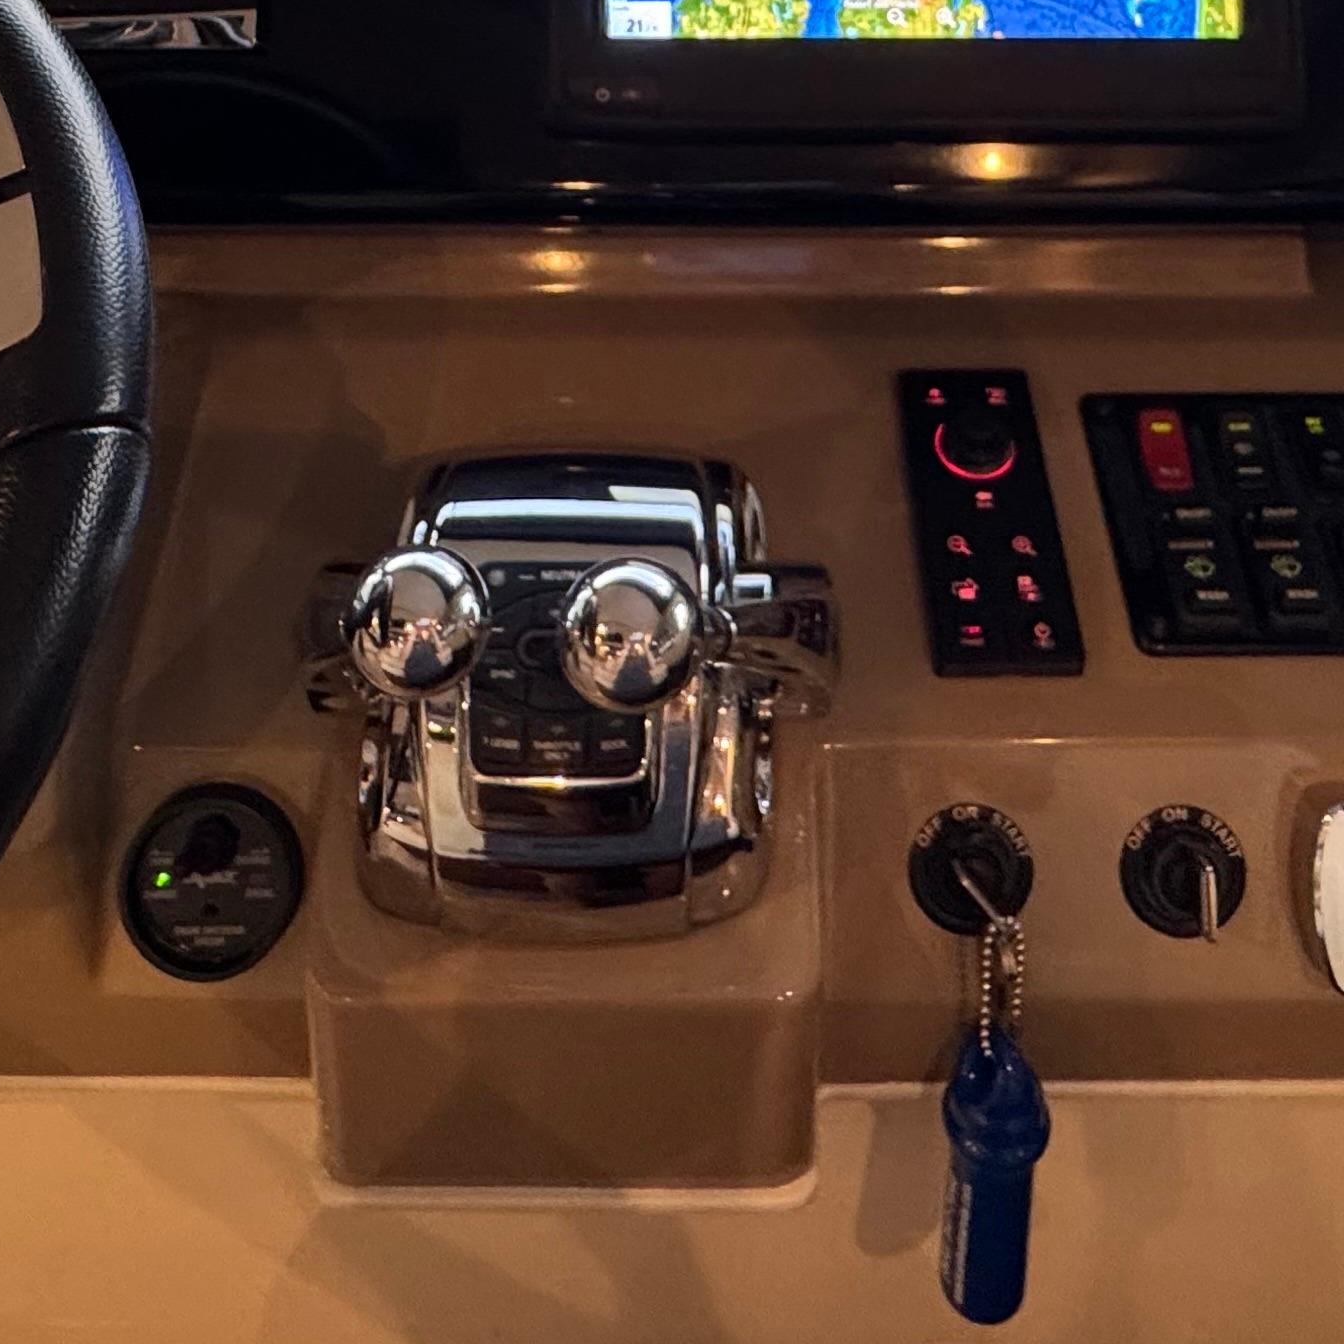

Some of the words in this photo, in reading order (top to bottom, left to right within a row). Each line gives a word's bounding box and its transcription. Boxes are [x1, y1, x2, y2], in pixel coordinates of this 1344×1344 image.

[917, 816, 943, 848] OFF
[993, 812, 1031, 856] START
[1127, 816, 1153, 852] OFF
[1161, 806, 1188, 823] ON
[1201, 813, 1243, 857] START
